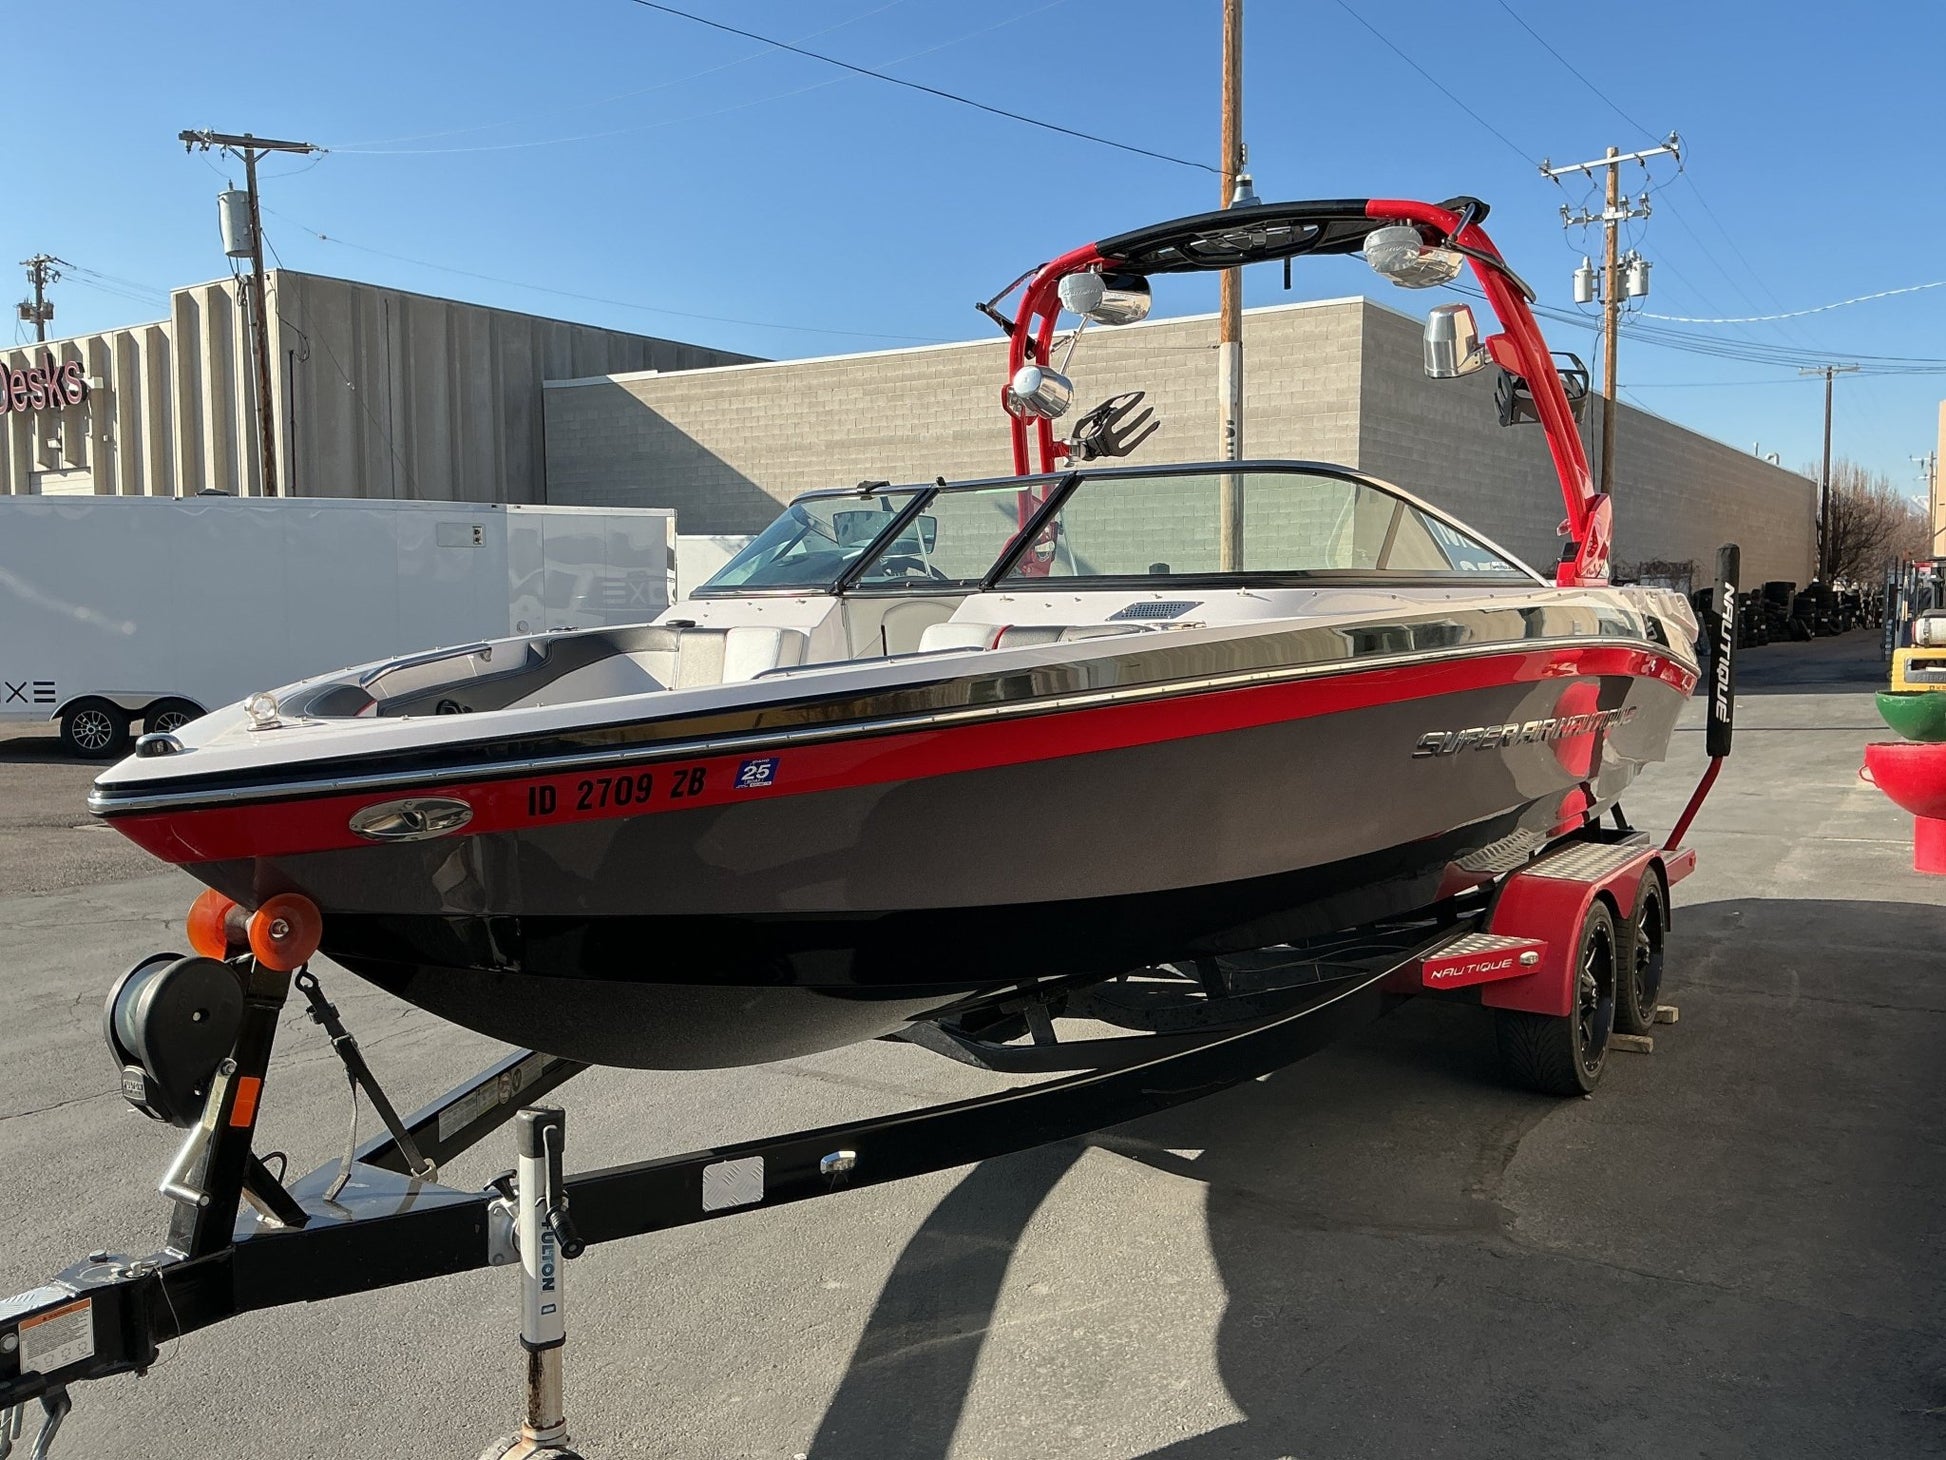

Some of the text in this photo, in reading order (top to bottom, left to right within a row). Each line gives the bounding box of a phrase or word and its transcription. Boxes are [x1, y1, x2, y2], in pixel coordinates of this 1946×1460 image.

[1715, 582, 1735, 723] NAUTIQUE
[1411, 722, 1520, 759] SUPER
[528, 767, 706, 816] ID 2709 ZB
[741, 763, 771, 780] 25
[1431, 959, 1513, 979] NAUTIQUE
[541, 1221, 555, 1291] FULTON
